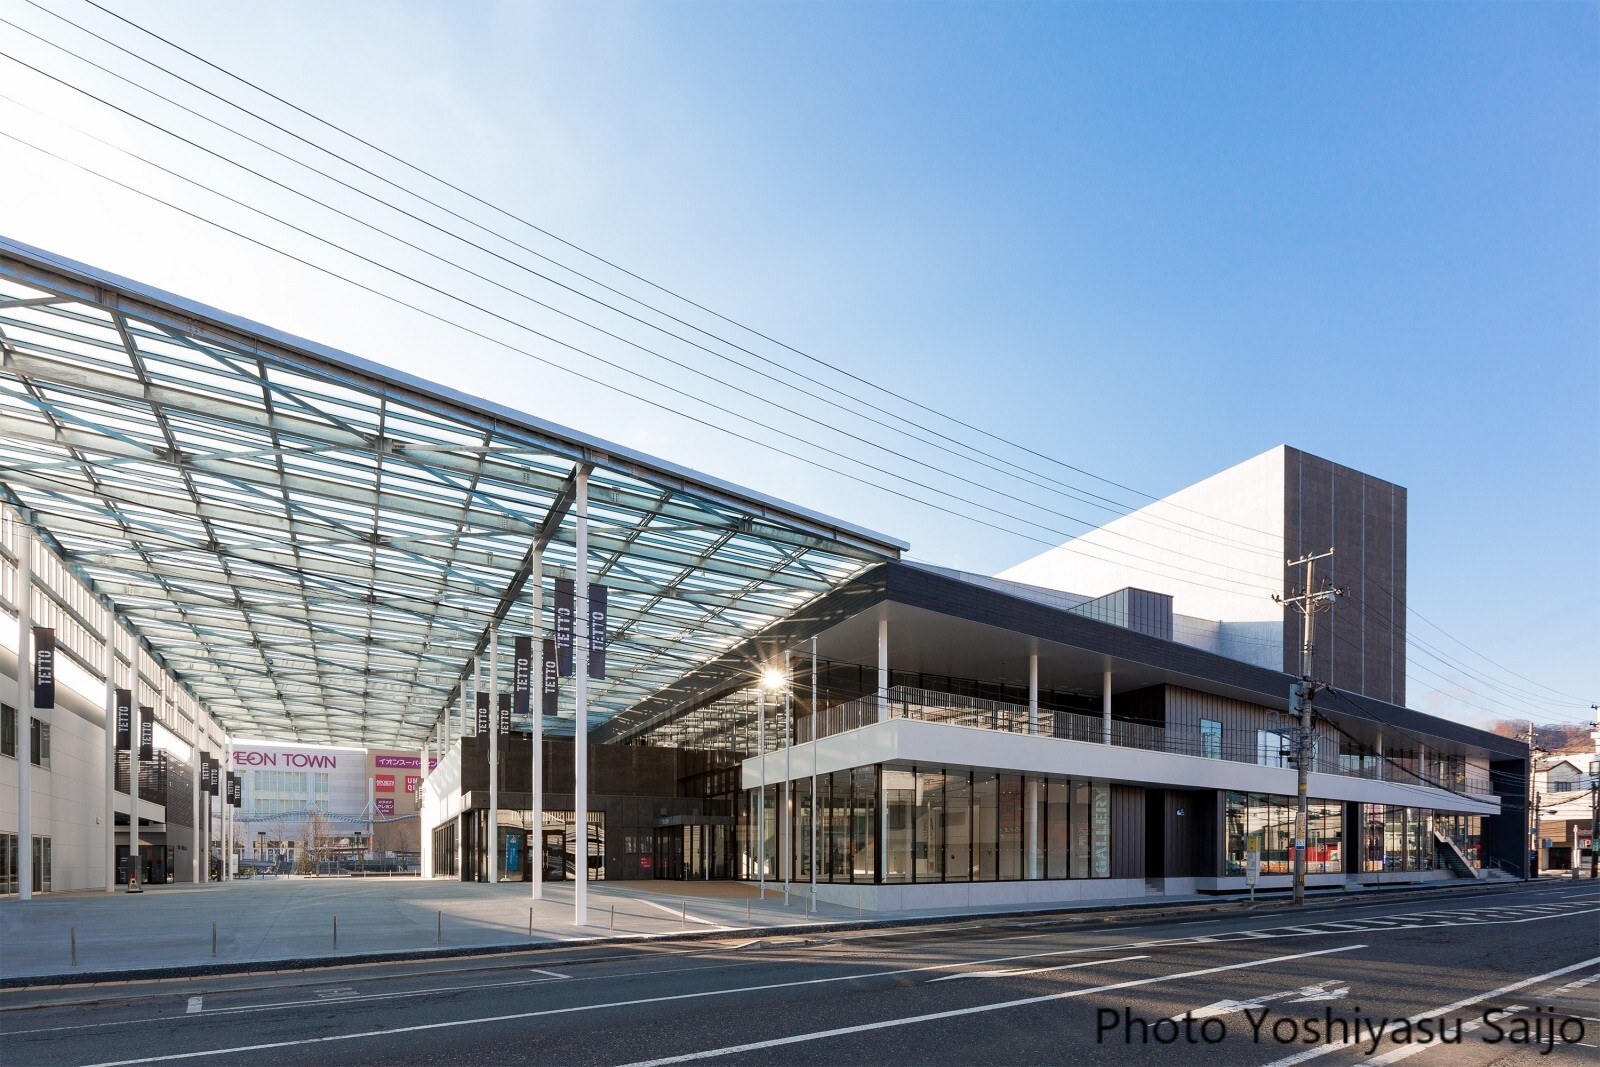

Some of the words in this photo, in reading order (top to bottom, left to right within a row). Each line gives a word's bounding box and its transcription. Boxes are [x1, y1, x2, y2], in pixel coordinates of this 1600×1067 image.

[557, 607, 570, 649] TETTO
[592, 611, 604, 651] TETTO
[38, 650, 51, 685] TETTO
[517, 658, 528, 692] TETTO
[544, 660, 556, 694] TETTO
[118, 706, 129, 732] TETTO
[142, 721, 152, 746] TETTO
[478, 708, 488, 733] TETTO
[500, 709, 509, 735] TETTO
[282, 753, 337, 768] TOWN
[1095, 788, 1107, 873] GALLERY
